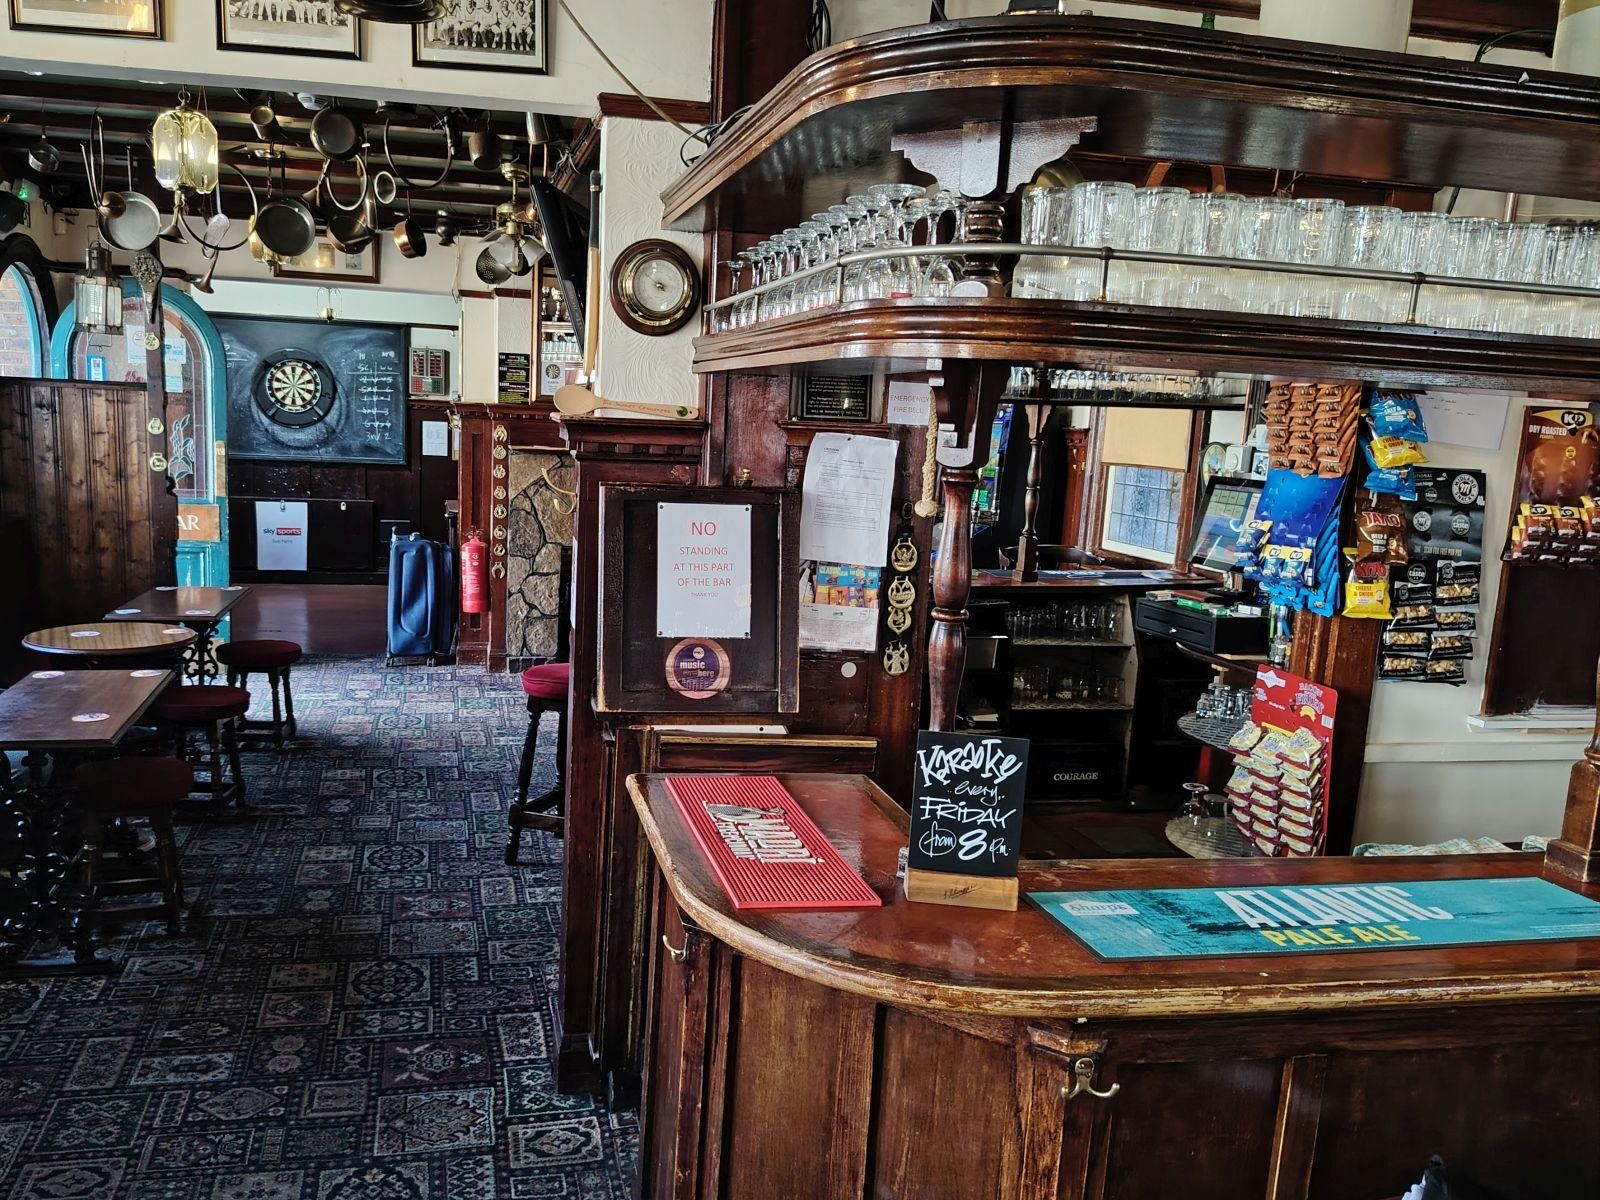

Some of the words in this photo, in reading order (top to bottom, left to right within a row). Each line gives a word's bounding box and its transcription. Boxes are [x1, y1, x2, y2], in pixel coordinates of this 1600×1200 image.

[1563, 413, 1585, 425] KP
[1529, 425, 1541, 433] DRY
[1541, 425, 1567, 436] ROASTED
[177, 514, 201, 531] AR
[263, 528, 275, 536] sky
[690, 521, 717, 536] NO
[679, 546, 728, 556] STANDING
[673, 562, 686, 572] AT
[688, 562, 710, 572] THIS
[711, 562, 735, 572] PART
[677, 577, 691, 587] OF
[692, 577, 711, 587] THE
[713, 577, 732, 587] BAR
[679, 659, 706, 669] music
[697, 669, 715, 678] here
[1053, 772, 1099, 781] COURAGE
[923, 821, 955, 858] from
[958, 828, 988, 861] 8
[1069, 904, 1128, 912] Sharp's
[1214, 885, 1454, 928] ATLANTIC
[1259, 928, 1355, 947] PALE
[1350, 924, 1422, 943] ALE
